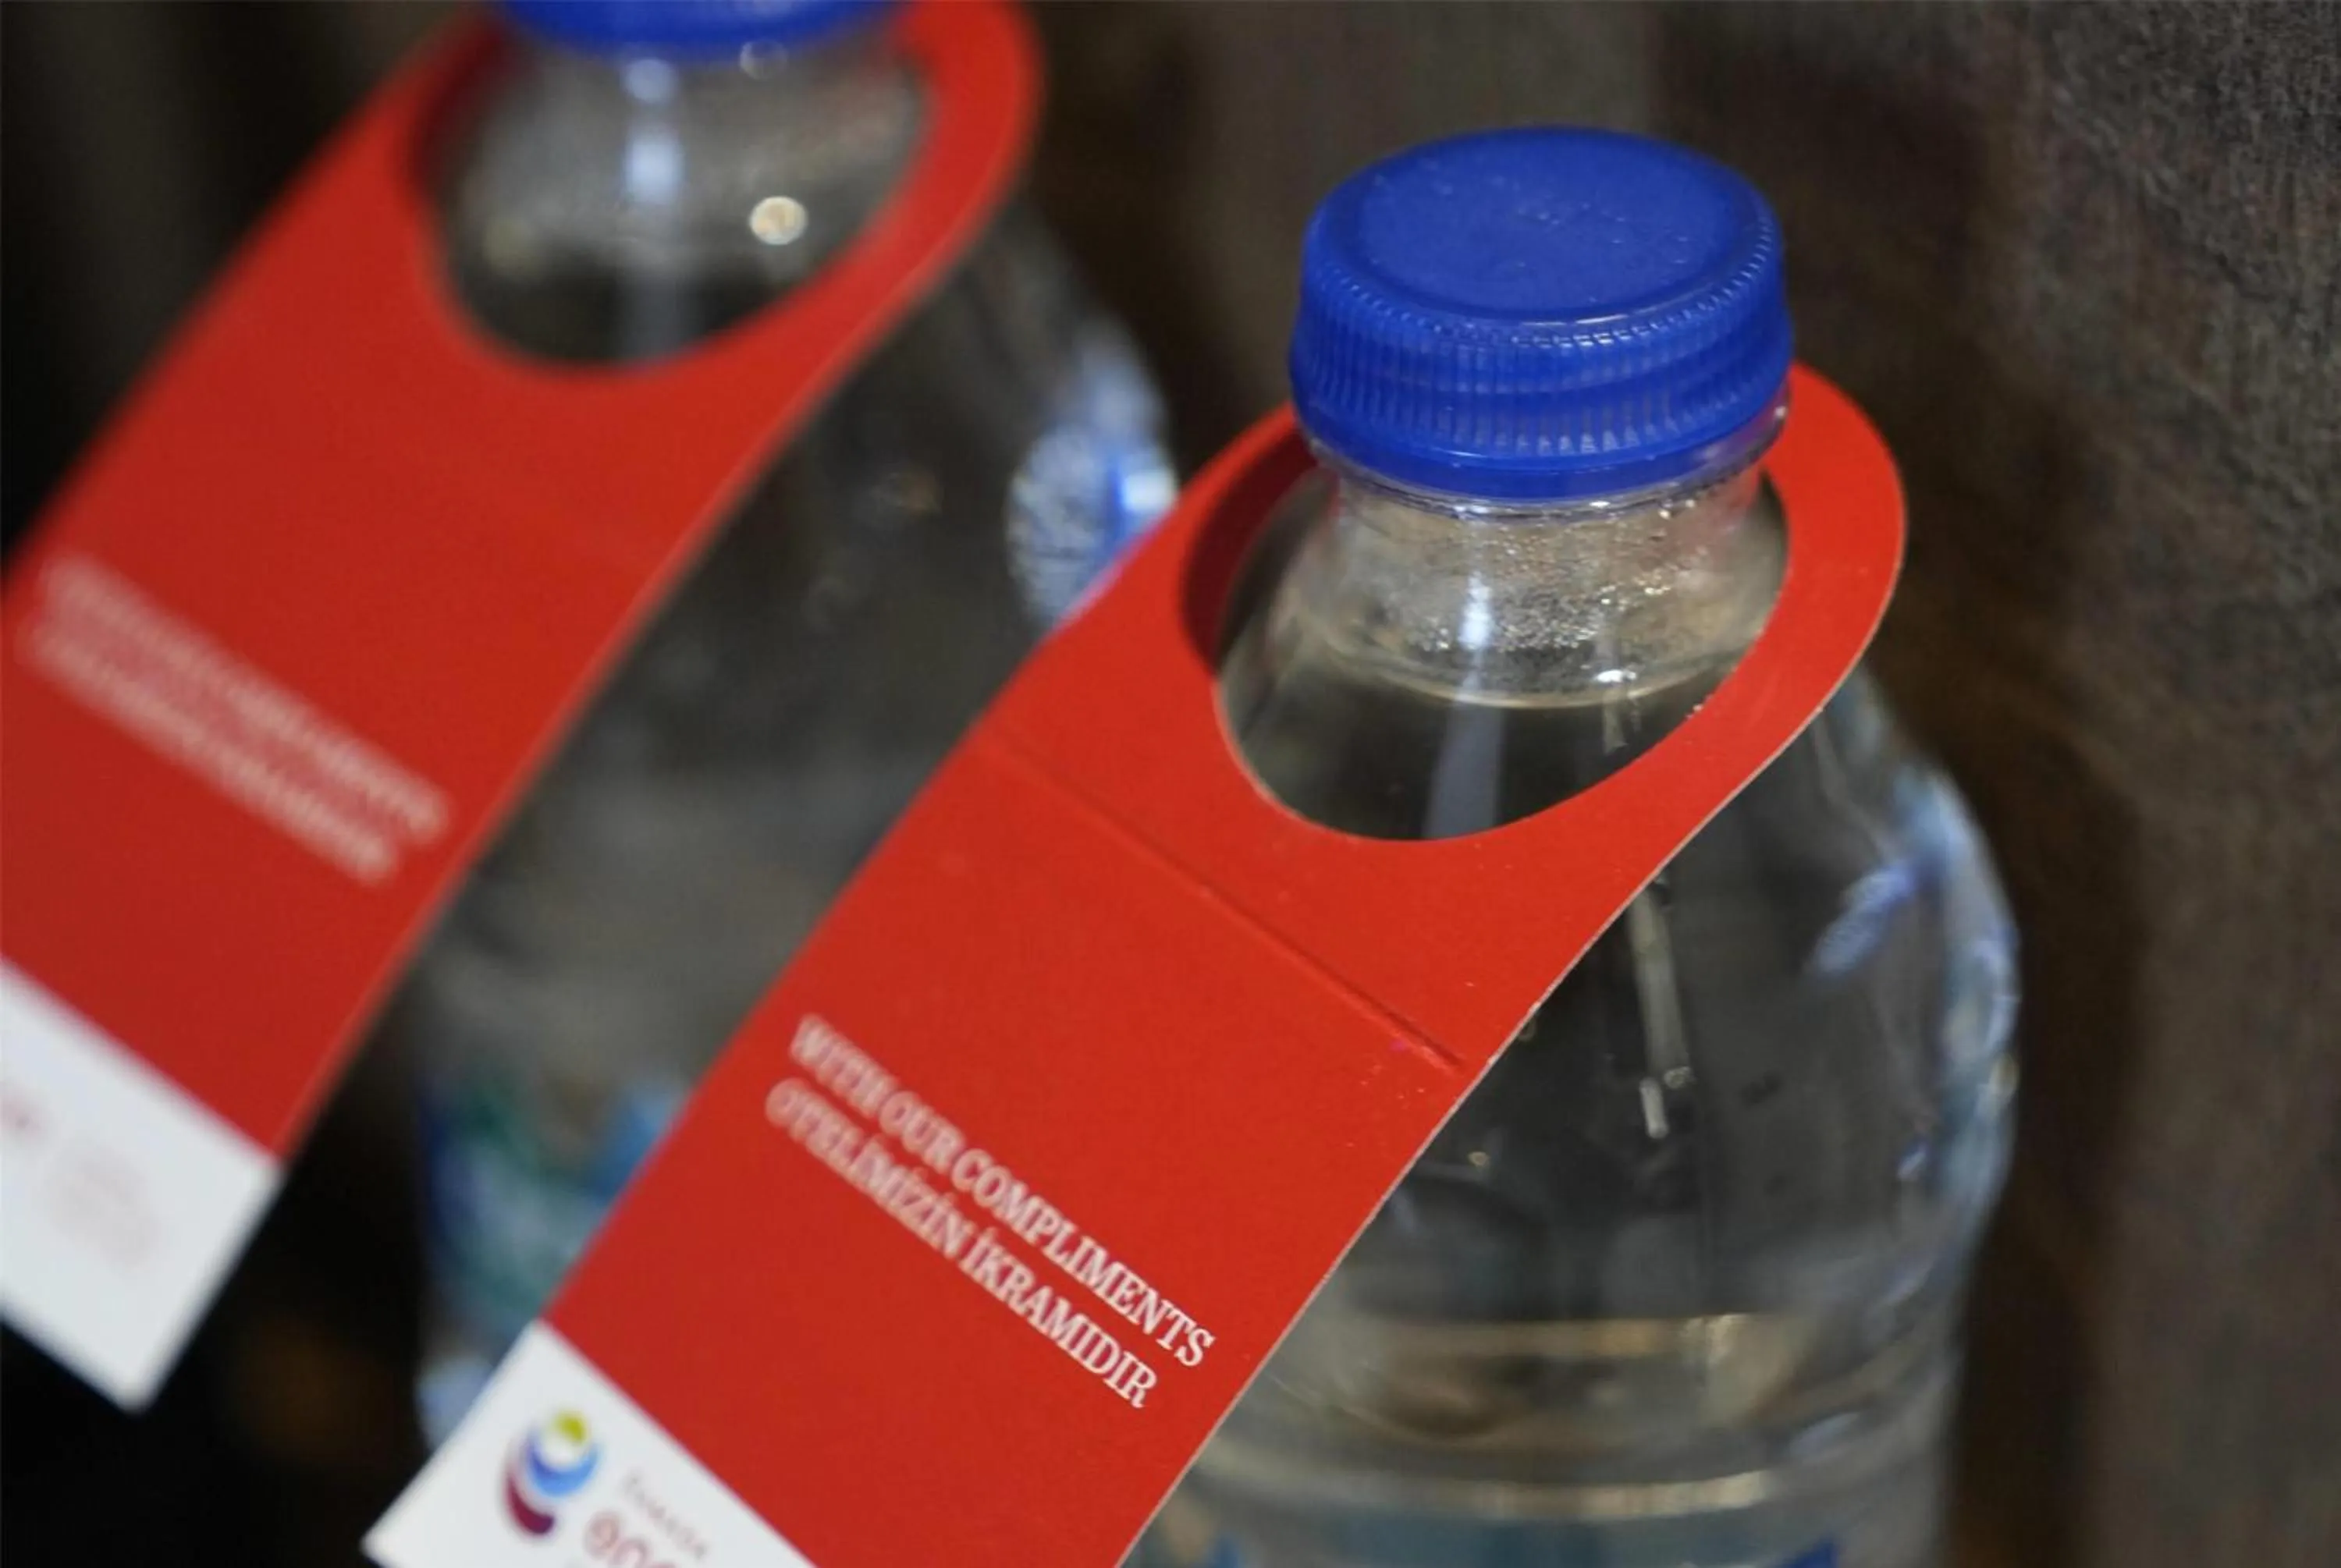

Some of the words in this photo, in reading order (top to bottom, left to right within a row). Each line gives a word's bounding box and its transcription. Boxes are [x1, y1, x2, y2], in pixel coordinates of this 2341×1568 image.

[790, 1014, 900, 1119] WITH
[879, 1091, 965, 1174] OUR
[951, 1148, 1215, 1367] COMPLIMENTS
